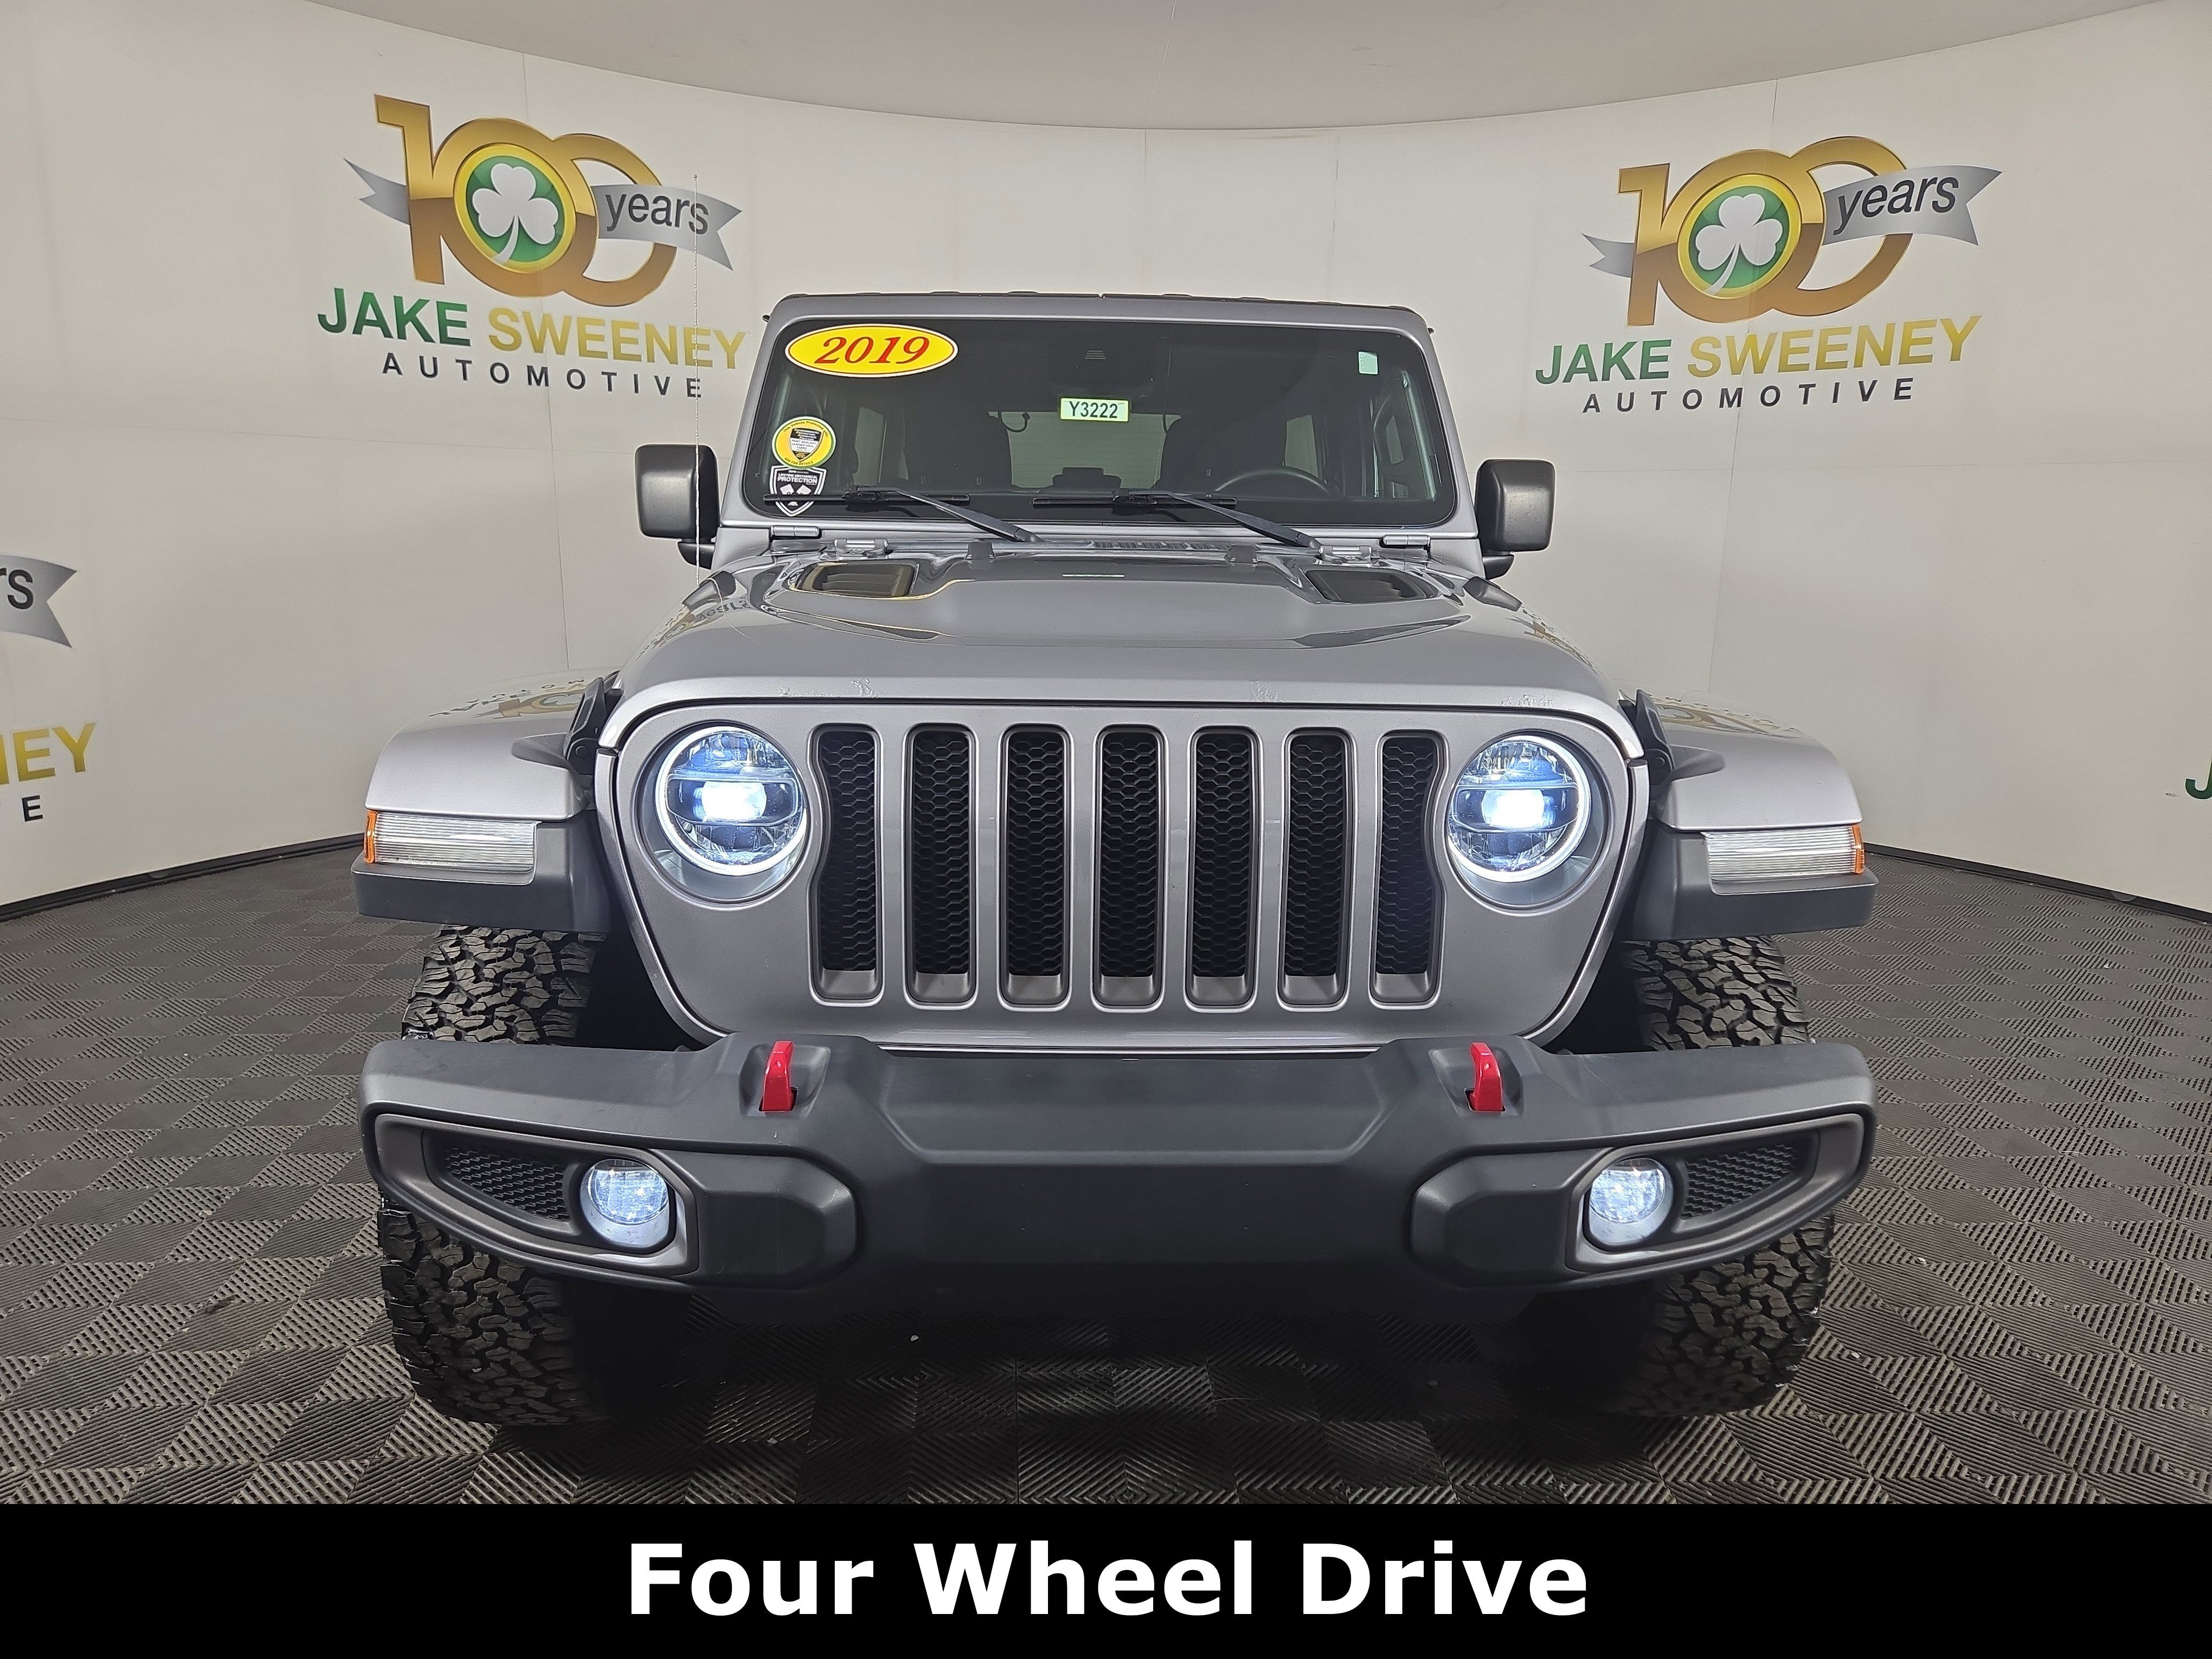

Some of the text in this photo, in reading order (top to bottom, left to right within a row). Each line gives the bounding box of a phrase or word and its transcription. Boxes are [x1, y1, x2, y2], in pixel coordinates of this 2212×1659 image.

[606, 191, 710, 235] years
[1833, 173, 1959, 236] years
[317, 287, 745, 370] JAKE SWEENEY
[814, 336, 930, 364] 2019
[1535, 314, 1982, 384] JAKE SWEENEY
[382, 352, 702, 398] AUTOMOTIVE
[1582, 377, 1914, 414] AUTOMOTIVE
[1069, 401, 1118, 419] Y3222
